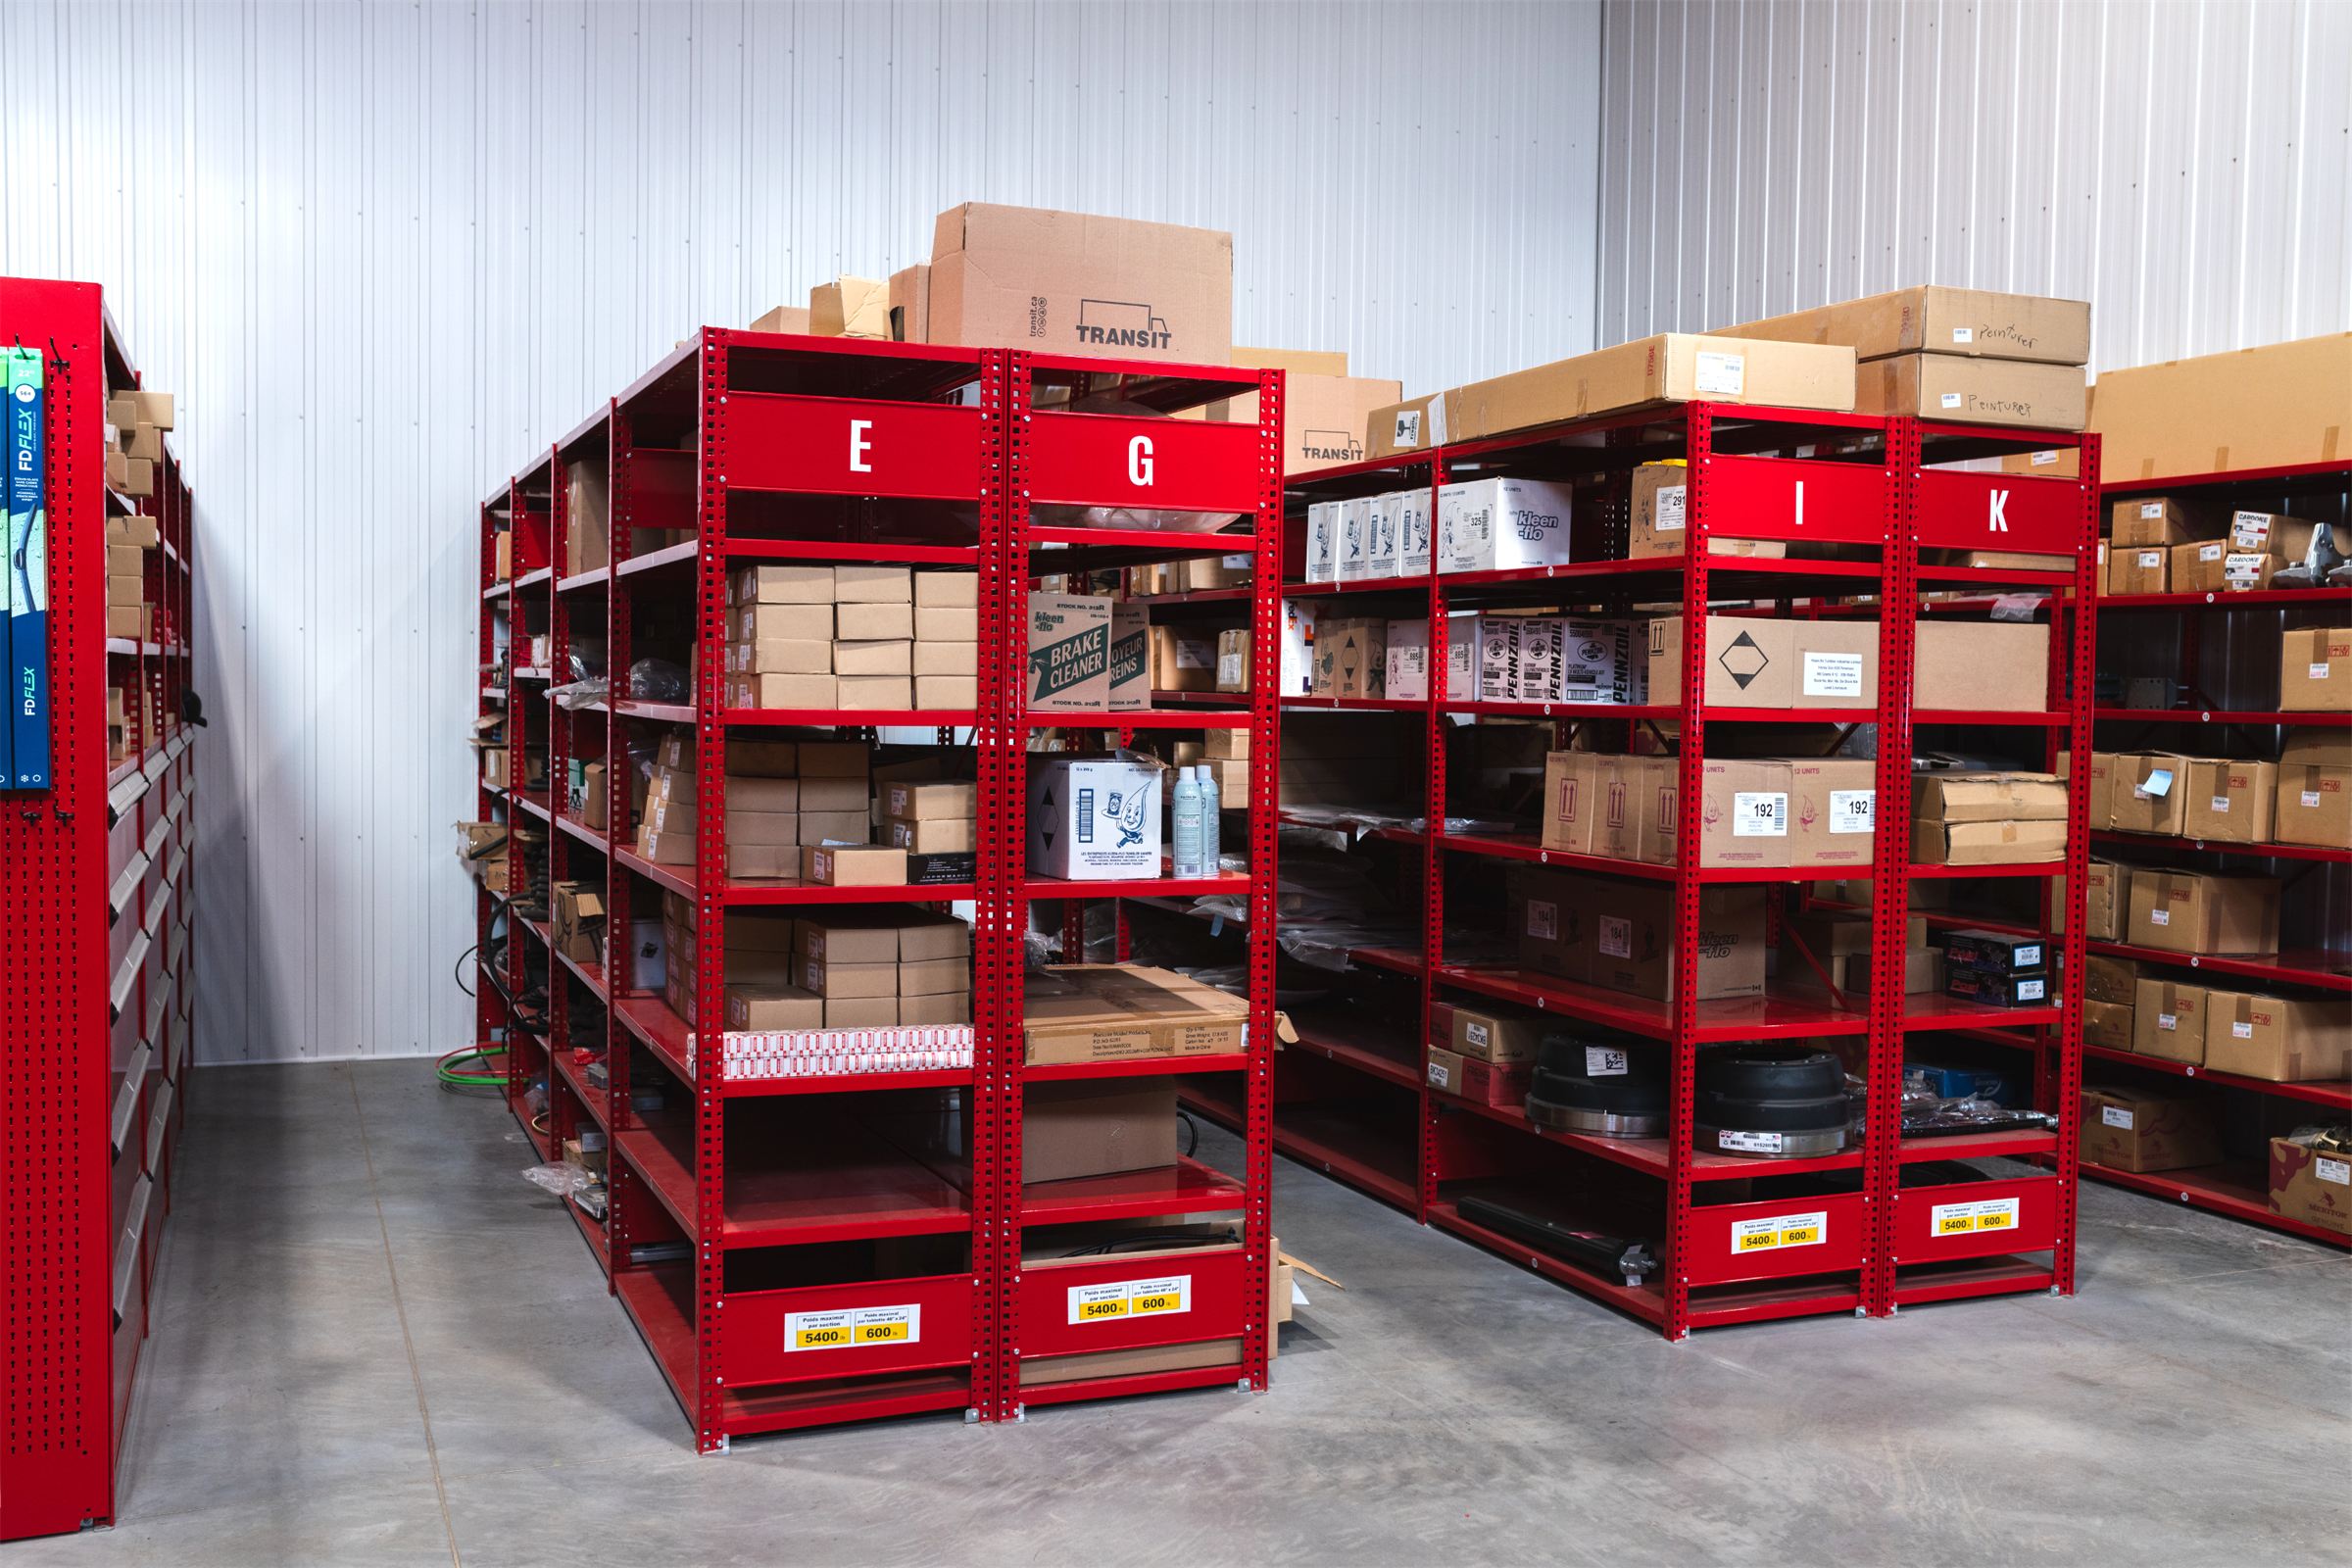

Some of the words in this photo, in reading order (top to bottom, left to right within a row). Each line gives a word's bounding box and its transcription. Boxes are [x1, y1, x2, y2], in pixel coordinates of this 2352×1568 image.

[1076, 324, 1171, 349] TRANSIT
[19, 408, 32, 471] FDFLEX
[851, 419, 871, 472] E
[1128, 436, 1153, 485] G
[1301, 447, 1363, 461] TRANSIT
[1795, 480, 1804, 525] I
[1517, 510, 1558, 528] kleen
[1989, 490, 2010, 532] K
[2238, 514, 2269, 523] CARDONE
[1470, 516, 1482, 526] 325
[1034, 612, 1064, 624] kleen
[1288, 601, 1298, 630] FedEx
[1051, 629, 1102, 667] BRAKE
[1508, 622, 1519, 700] PENNZOIL
[1550, 622, 1562, 701] PENNZOIL
[1613, 625, 1630, 703] PENNZOIL
[1050, 652, 1102, 689] CLEANER
[24, 666, 36, 715] FDFLEX
[1754, 803, 1773, 817] 192
[1848, 801, 1868, 814] 192
[2309, 1203, 2348, 1219] MERITOR
[1945, 1220, 1967, 1230] 5400
[1984, 1216, 2000, 1226] 600
[1746, 1235, 1770, 1247] 5400
[1788, 1231, 1806, 1241] 600
[1088, 1303, 1117, 1315] 5400
[1143, 1298, 1165, 1309] 600
[806, 1331, 839, 1344] 5400
[866, 1327, 891, 1339] 600
